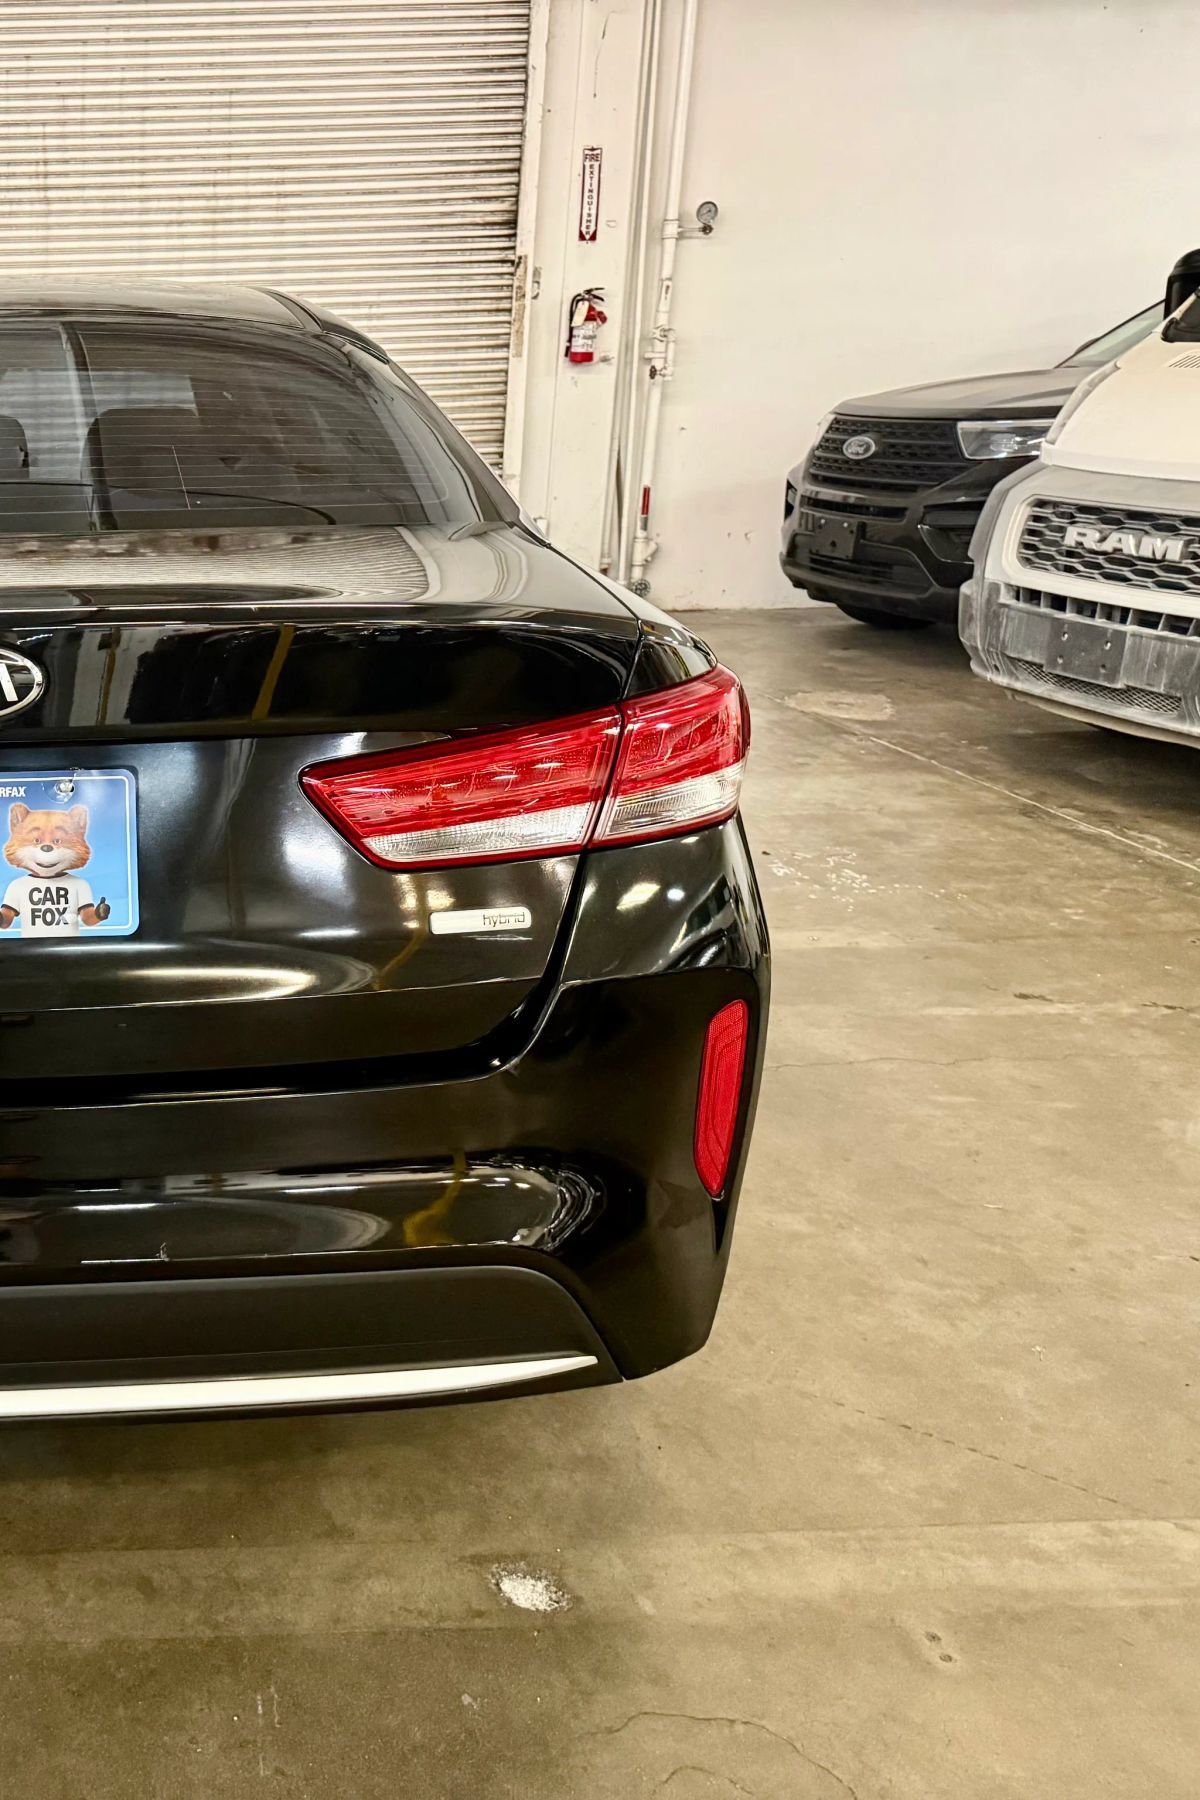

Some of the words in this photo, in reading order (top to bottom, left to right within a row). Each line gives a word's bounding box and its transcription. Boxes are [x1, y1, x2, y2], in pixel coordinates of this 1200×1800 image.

[584, 153, 601, 163] FIRE
[585, 163, 595, 236] EXTINGUISHER
[1062, 524, 1188, 562] RAM
[28, 886, 69, 906] CAR
[30, 906, 69, 926] FOX
[482, 911, 526, 928] hybrid
